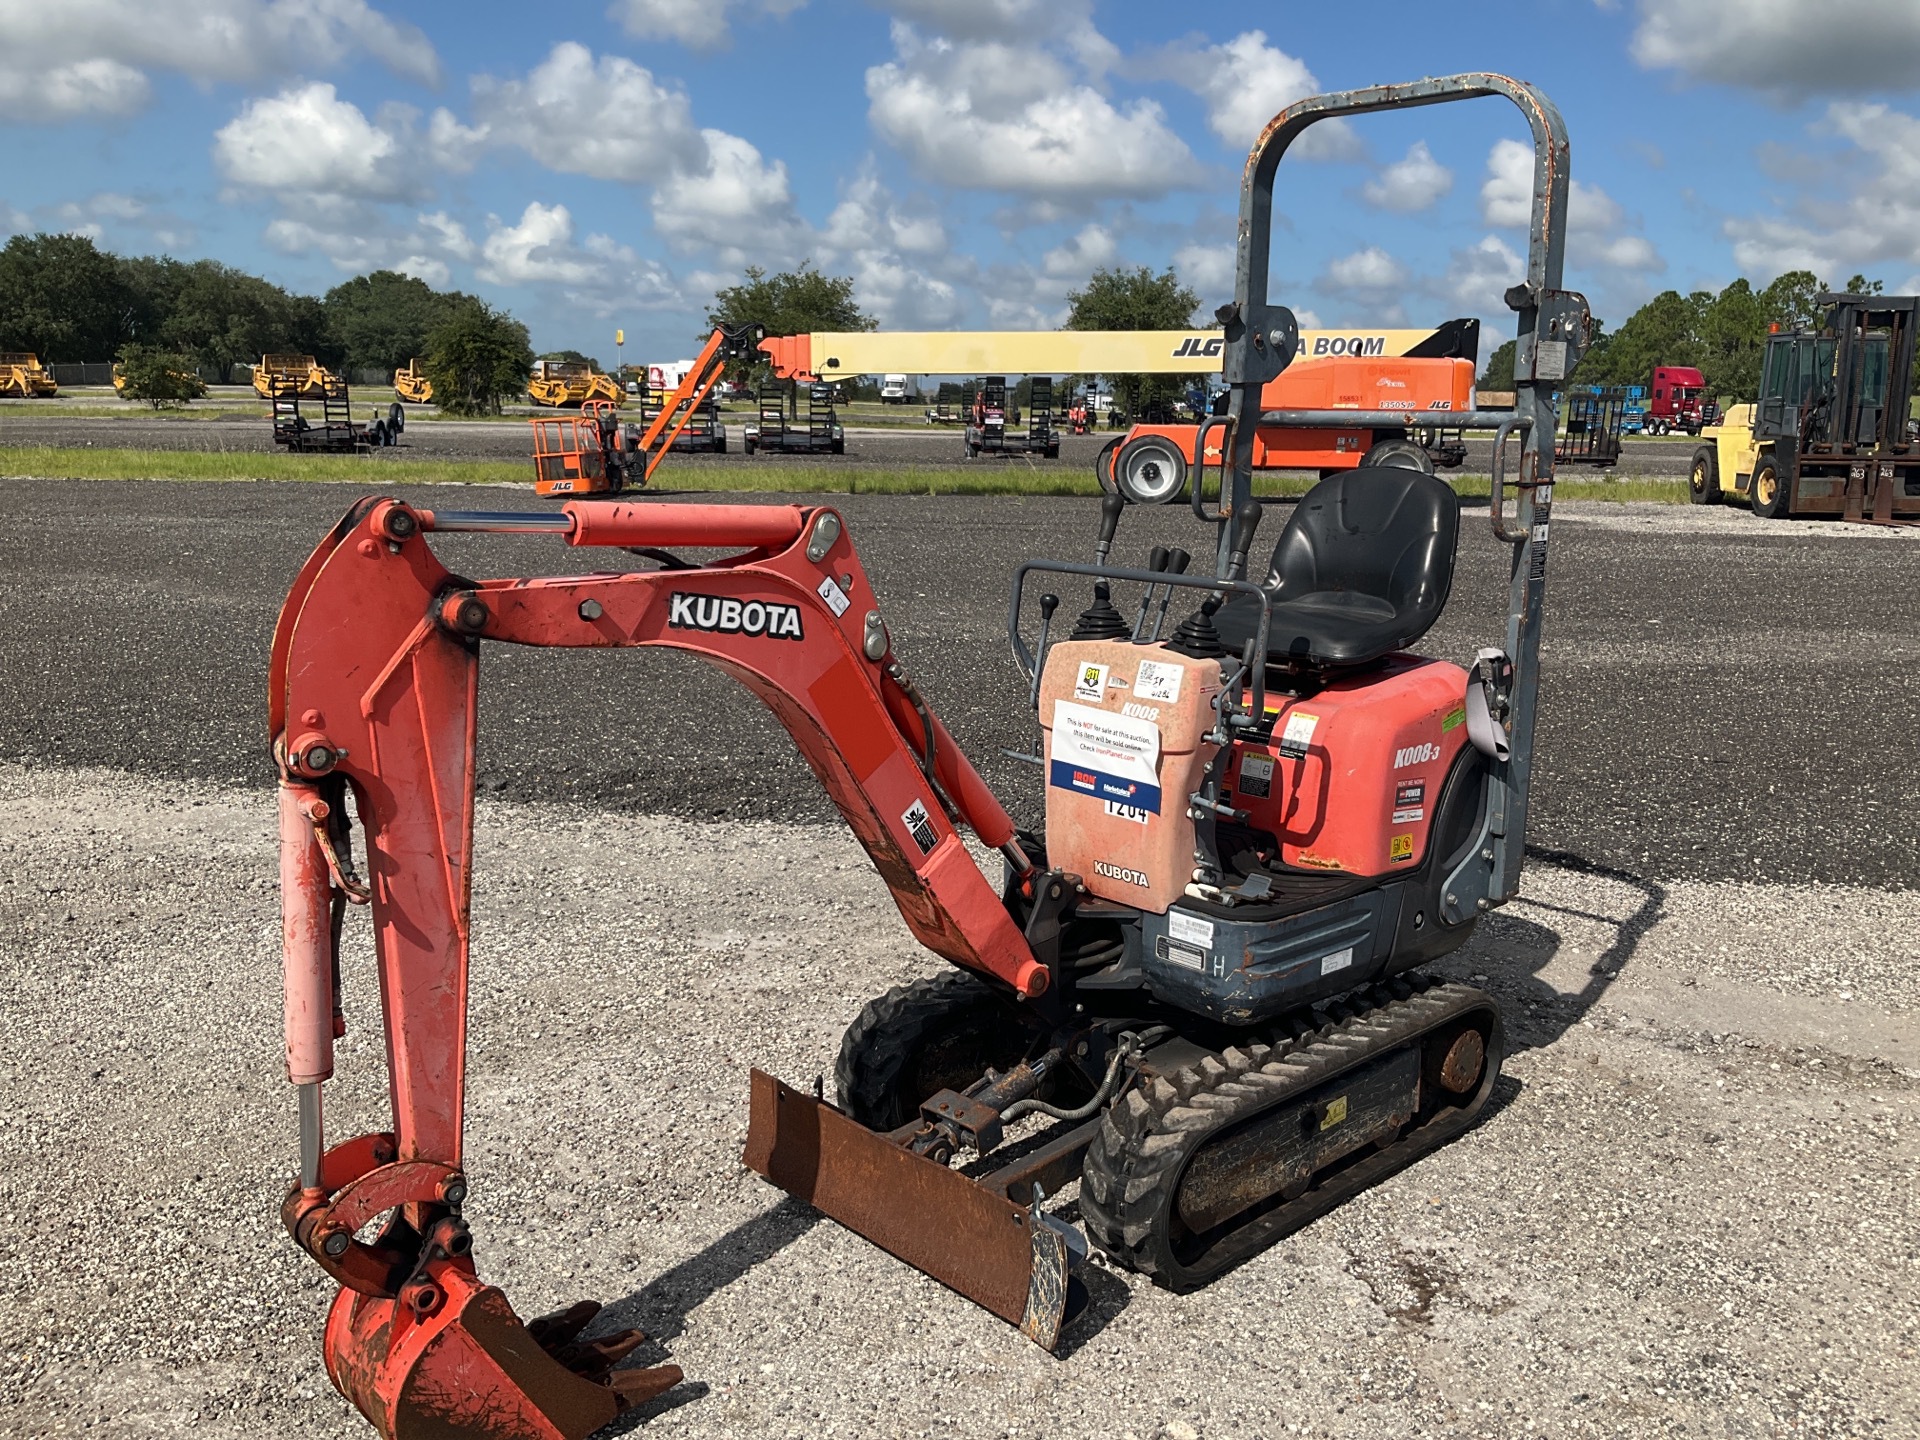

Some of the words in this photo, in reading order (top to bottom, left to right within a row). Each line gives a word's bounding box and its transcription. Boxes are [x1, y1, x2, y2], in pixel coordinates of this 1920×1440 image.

[1172, 338, 1225, 357] JLG
[1313, 337, 1385, 356] BOOM
[1428, 401, 1451, 409] JLG
[551, 482, 572, 491] JLG
[670, 593, 802, 637] KUBOTA
[1085, 667, 1100, 680] 811
[1067, 717, 1077, 726] This
[1083, 721, 1094, 730] NOT
[1101, 726, 1112, 734] sale
[1119, 730, 1129, 739] this
[1073, 729, 1083, 738] this
[1084, 731, 1095, 740] item
[1095, 734, 1104, 742] will
[1105, 736, 1111, 744] be
[1112, 739, 1123, 747] sold
[1080, 743, 1095, 753] Check
[1096, 747, 1136, 761] IronPlanet.com
[1393, 742, 1441, 769] K008-3
[1073, 771, 1096, 785] IRON
[1093, 860, 1149, 888] KUBOTA
